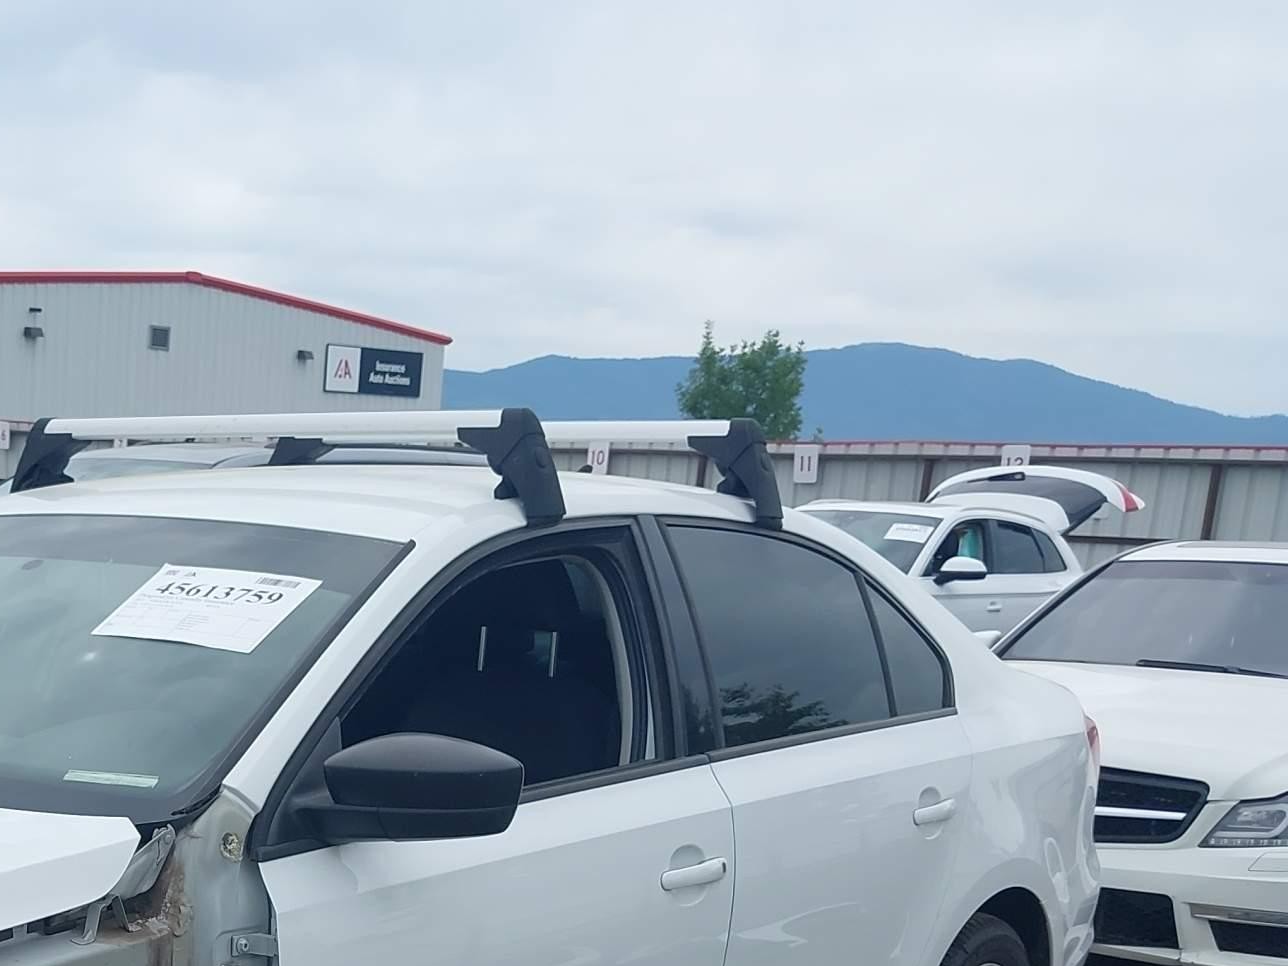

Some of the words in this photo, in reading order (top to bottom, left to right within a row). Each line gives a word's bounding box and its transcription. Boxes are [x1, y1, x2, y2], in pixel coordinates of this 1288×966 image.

[368, 371, 384, 384] Auto
[590, 450, 605, 465] 10
[799, 455, 812, 472] 11
[155, 580, 285, 606] 45613759
